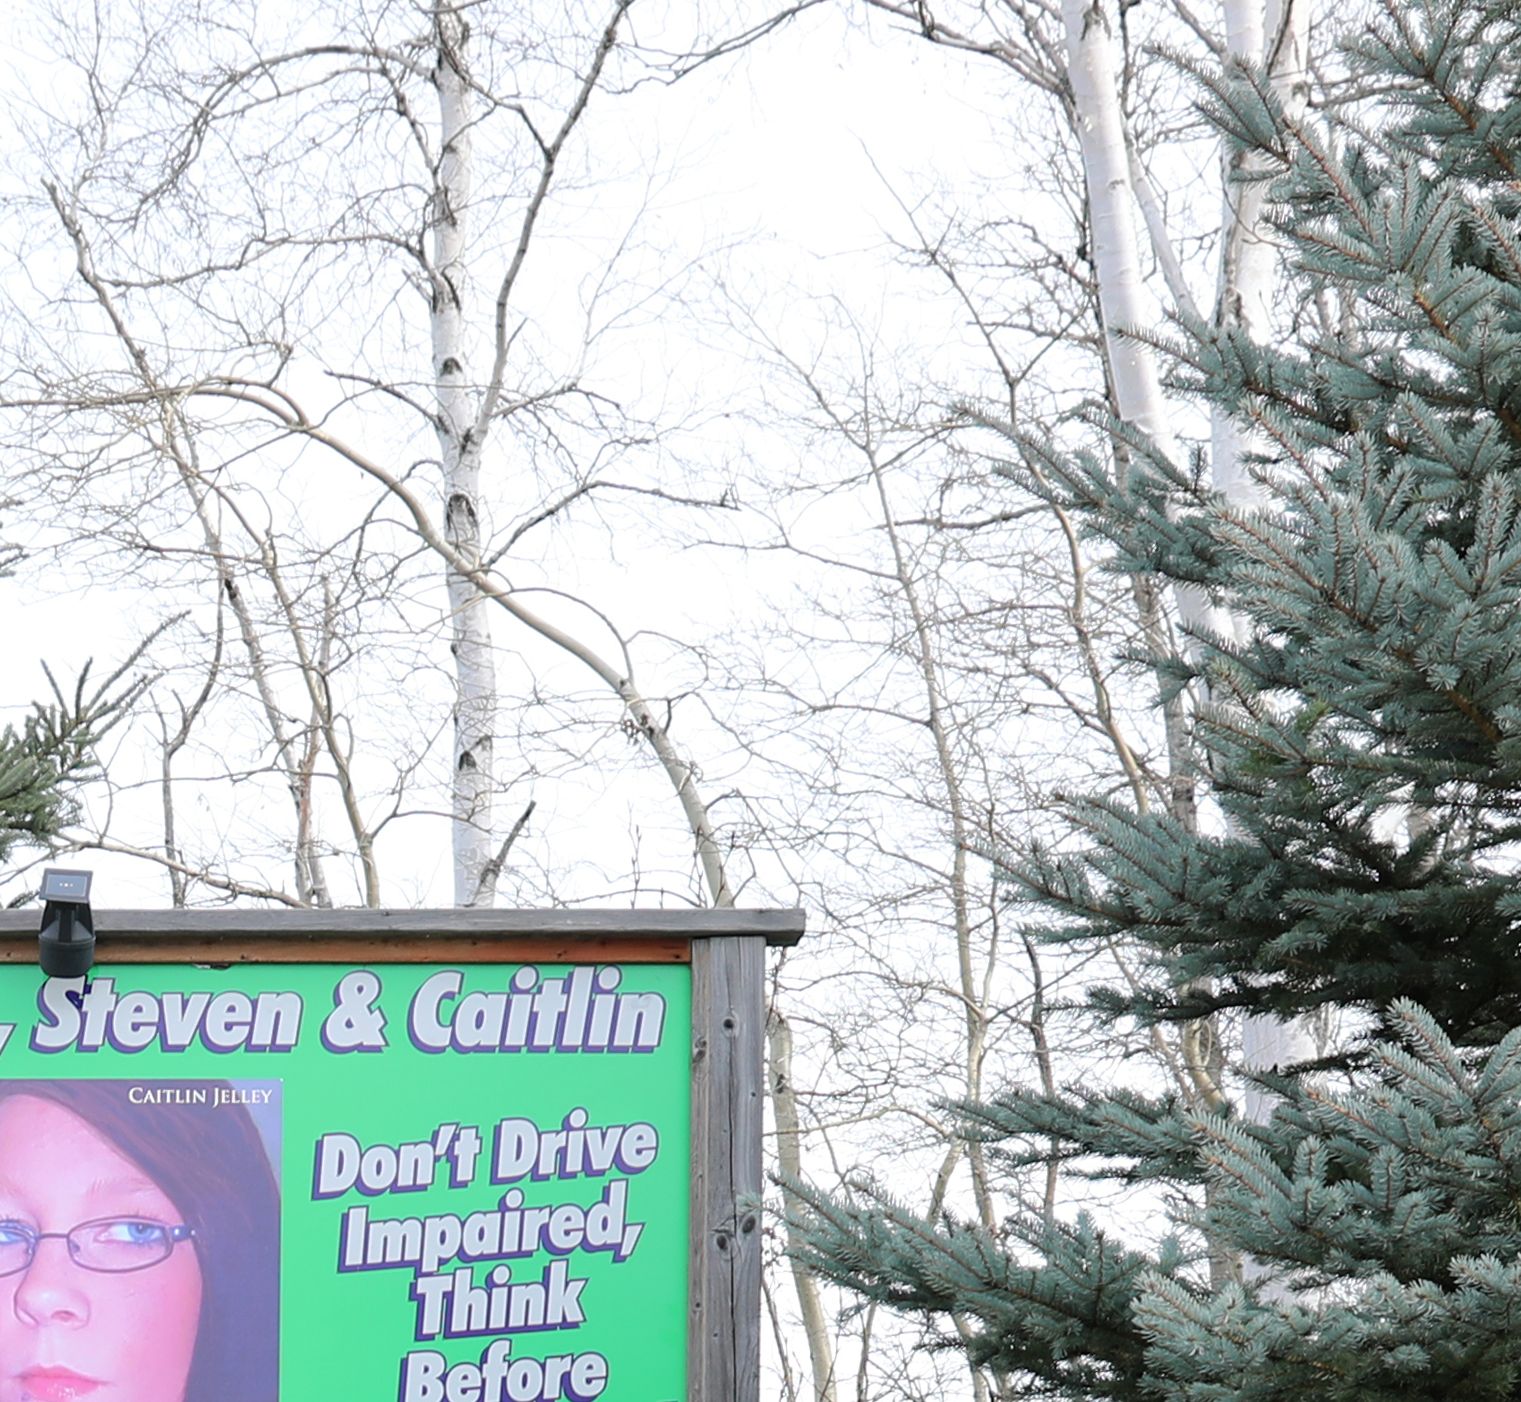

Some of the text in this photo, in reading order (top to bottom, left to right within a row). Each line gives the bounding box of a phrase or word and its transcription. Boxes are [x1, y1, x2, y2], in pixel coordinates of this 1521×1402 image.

[29, 975, 303, 1053] Steven
[321, 970, 388, 1053] &
[407, 965, 667, 1053] Caitlin
[128, 1087, 272, 1106] CAITLIN JELLEY
[312, 1107, 658, 1200] Don't Drive
[337, 1179, 645, 1278] Impaired,
[409, 1260, 588, 1341] Think
